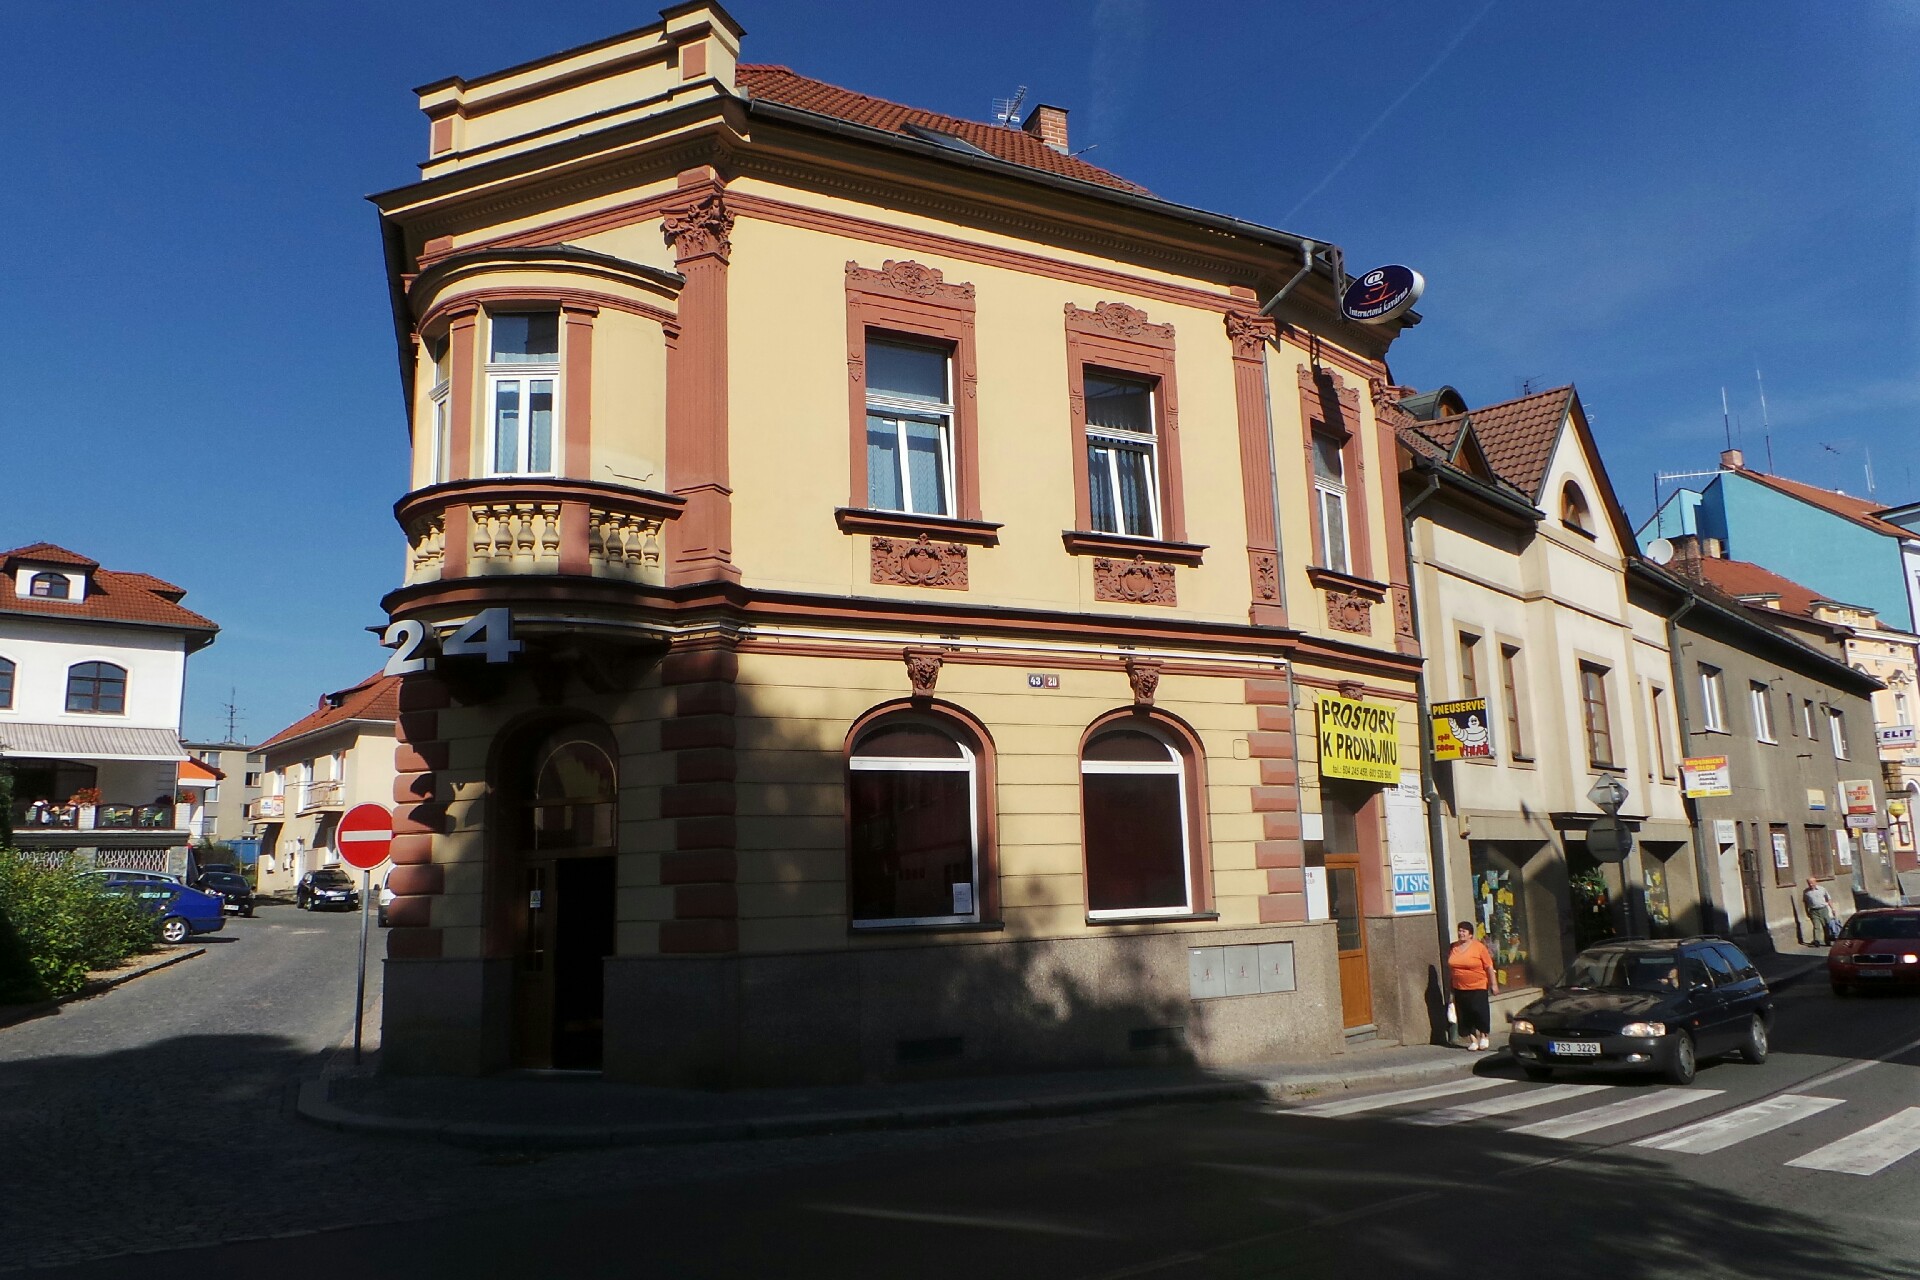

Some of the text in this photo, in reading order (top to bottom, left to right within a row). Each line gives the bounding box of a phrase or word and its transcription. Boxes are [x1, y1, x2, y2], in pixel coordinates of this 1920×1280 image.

[1030, 676, 1041, 686] 43
[1048, 677, 1057, 687] 20
[1432, 700, 1486, 715] PNEUSERVIS
[1321, 699, 1396, 735] PROSTORY
[1322, 731, 1397, 766] K PRONÁJMU
[1556, 1043, 1597, 1053] 7S3 3229
